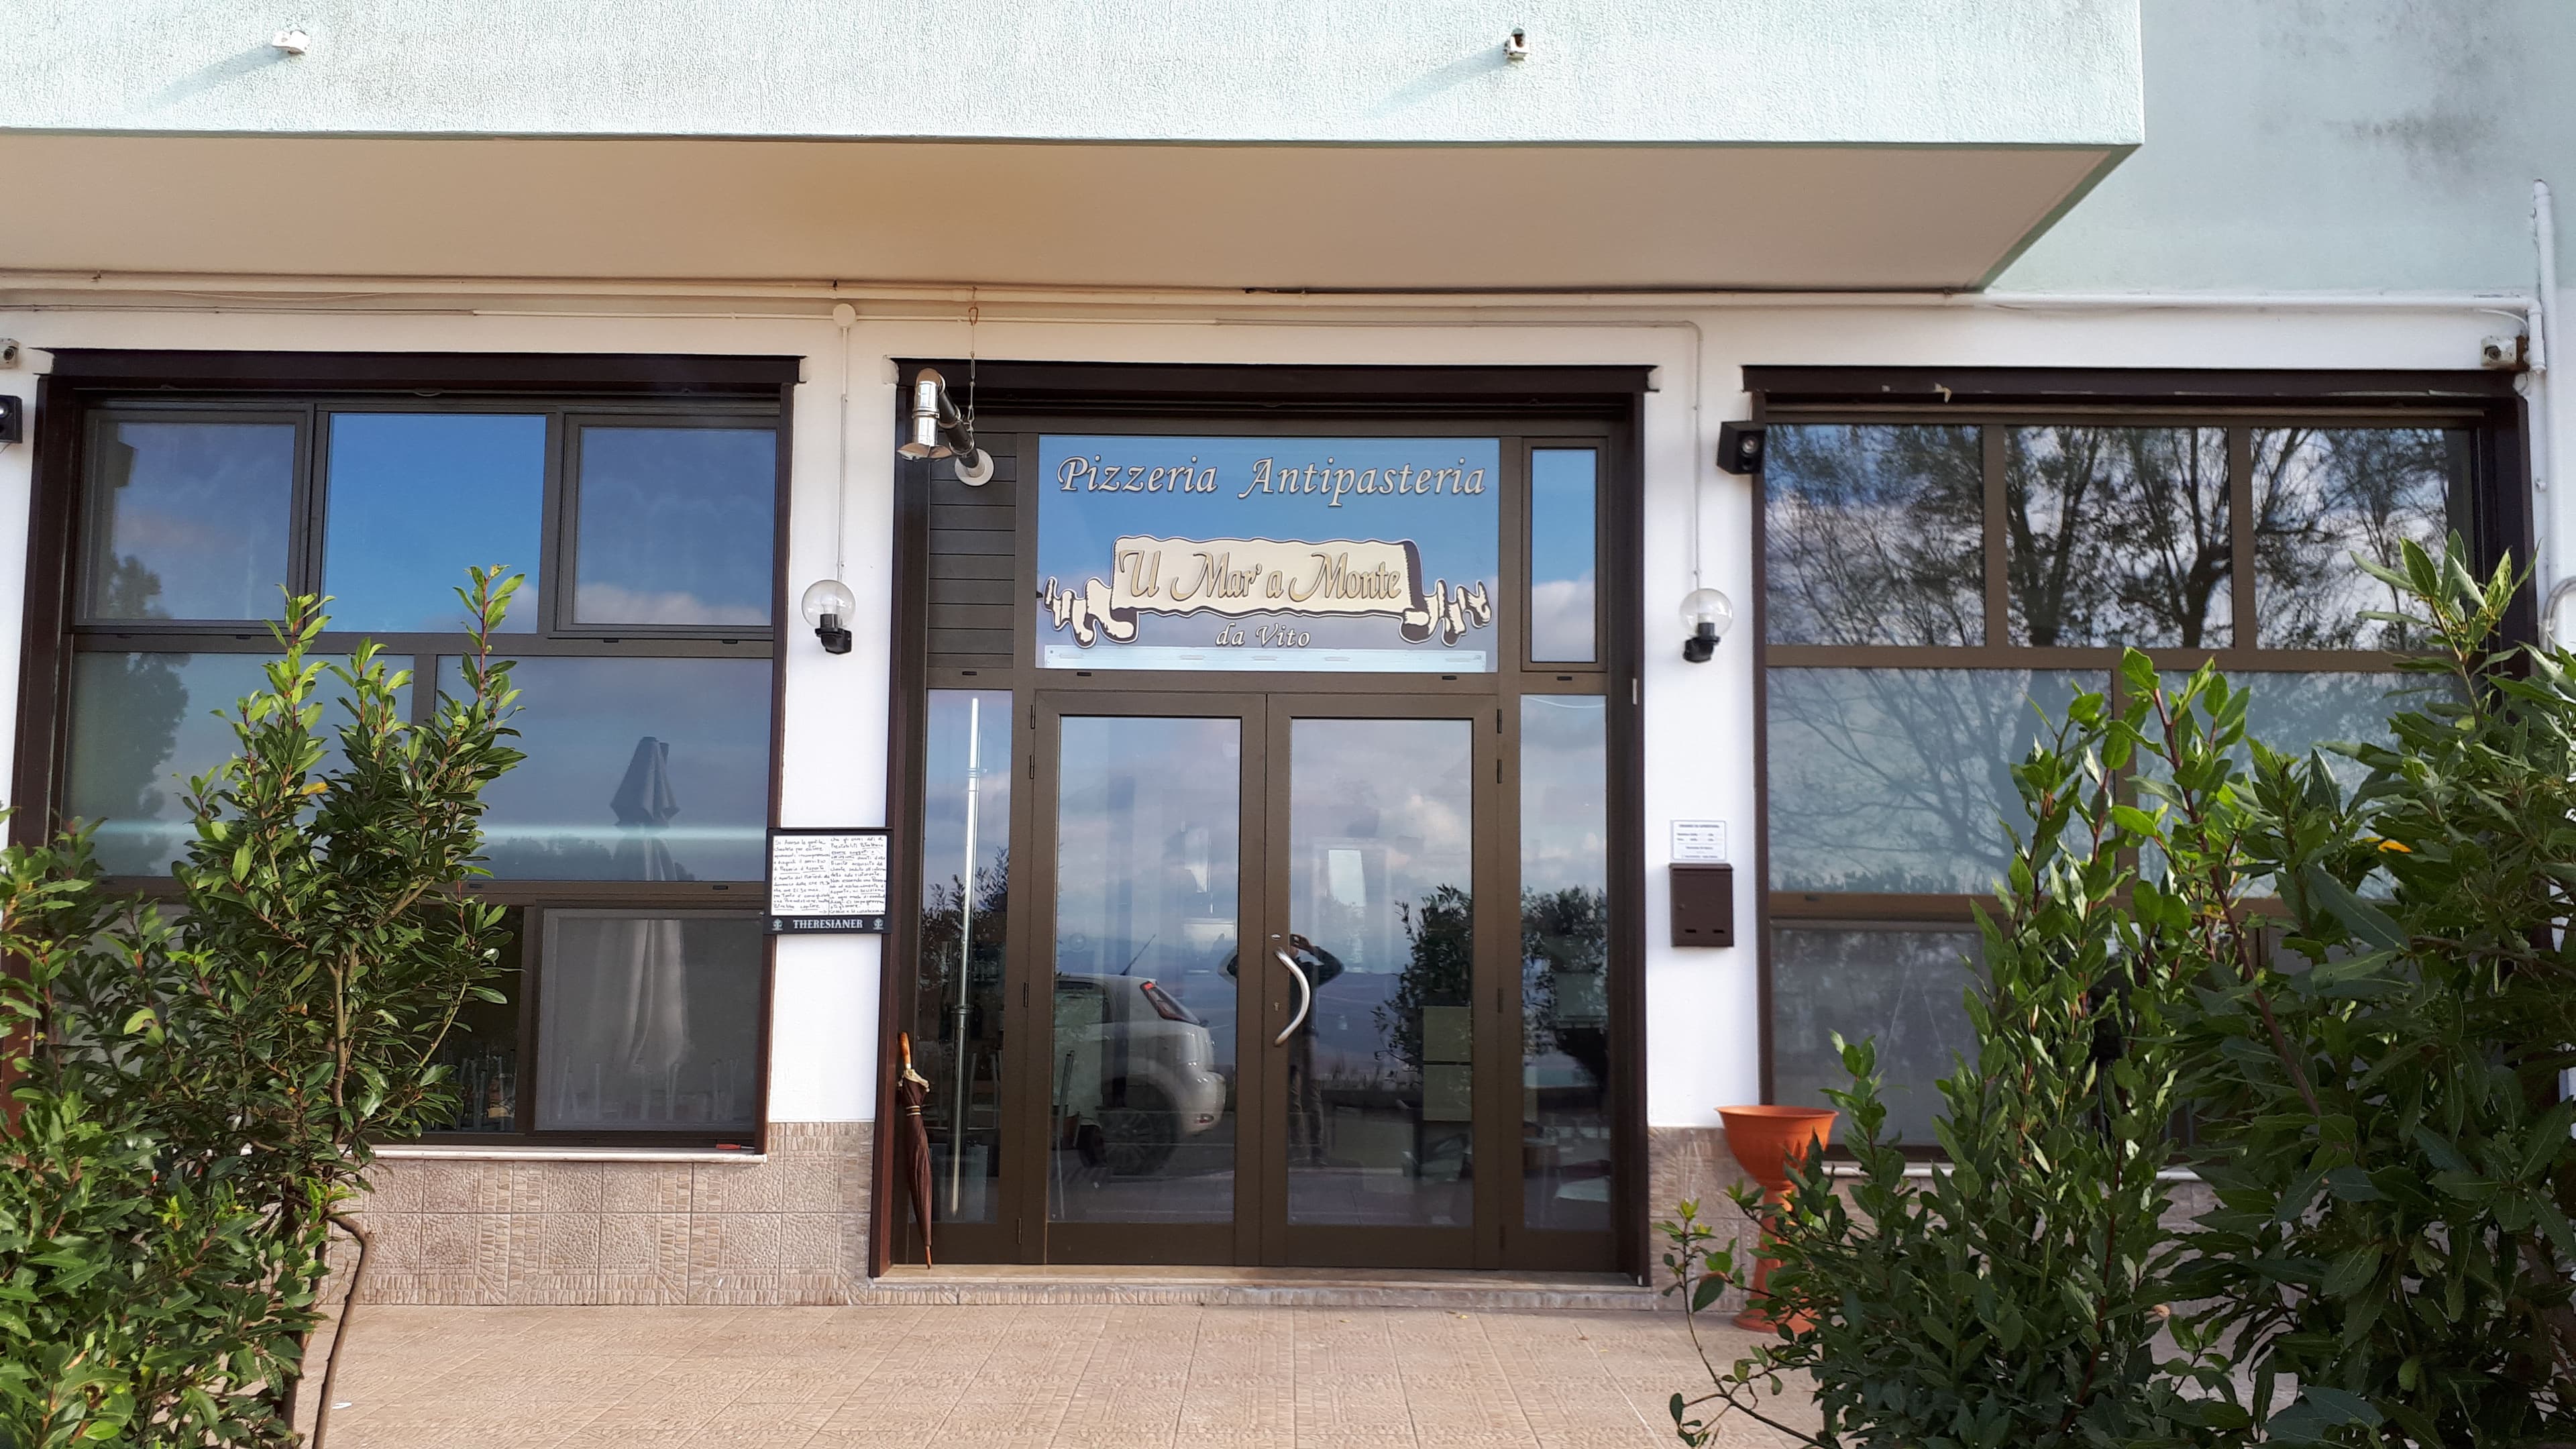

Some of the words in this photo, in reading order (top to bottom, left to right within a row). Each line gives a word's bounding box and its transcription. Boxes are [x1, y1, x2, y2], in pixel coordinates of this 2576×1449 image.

[1057, 455, 1218, 493] Pizzeria
[1237, 457, 1486, 507] Antipasteria
[1118, 549, 1162, 598] U
[1288, 551, 1402, 602] Monte
[1215, 623, 1246, 647] da
[1255, 623, 1311, 647] Vito
[793, 919, 863, 929] THERESIANER
